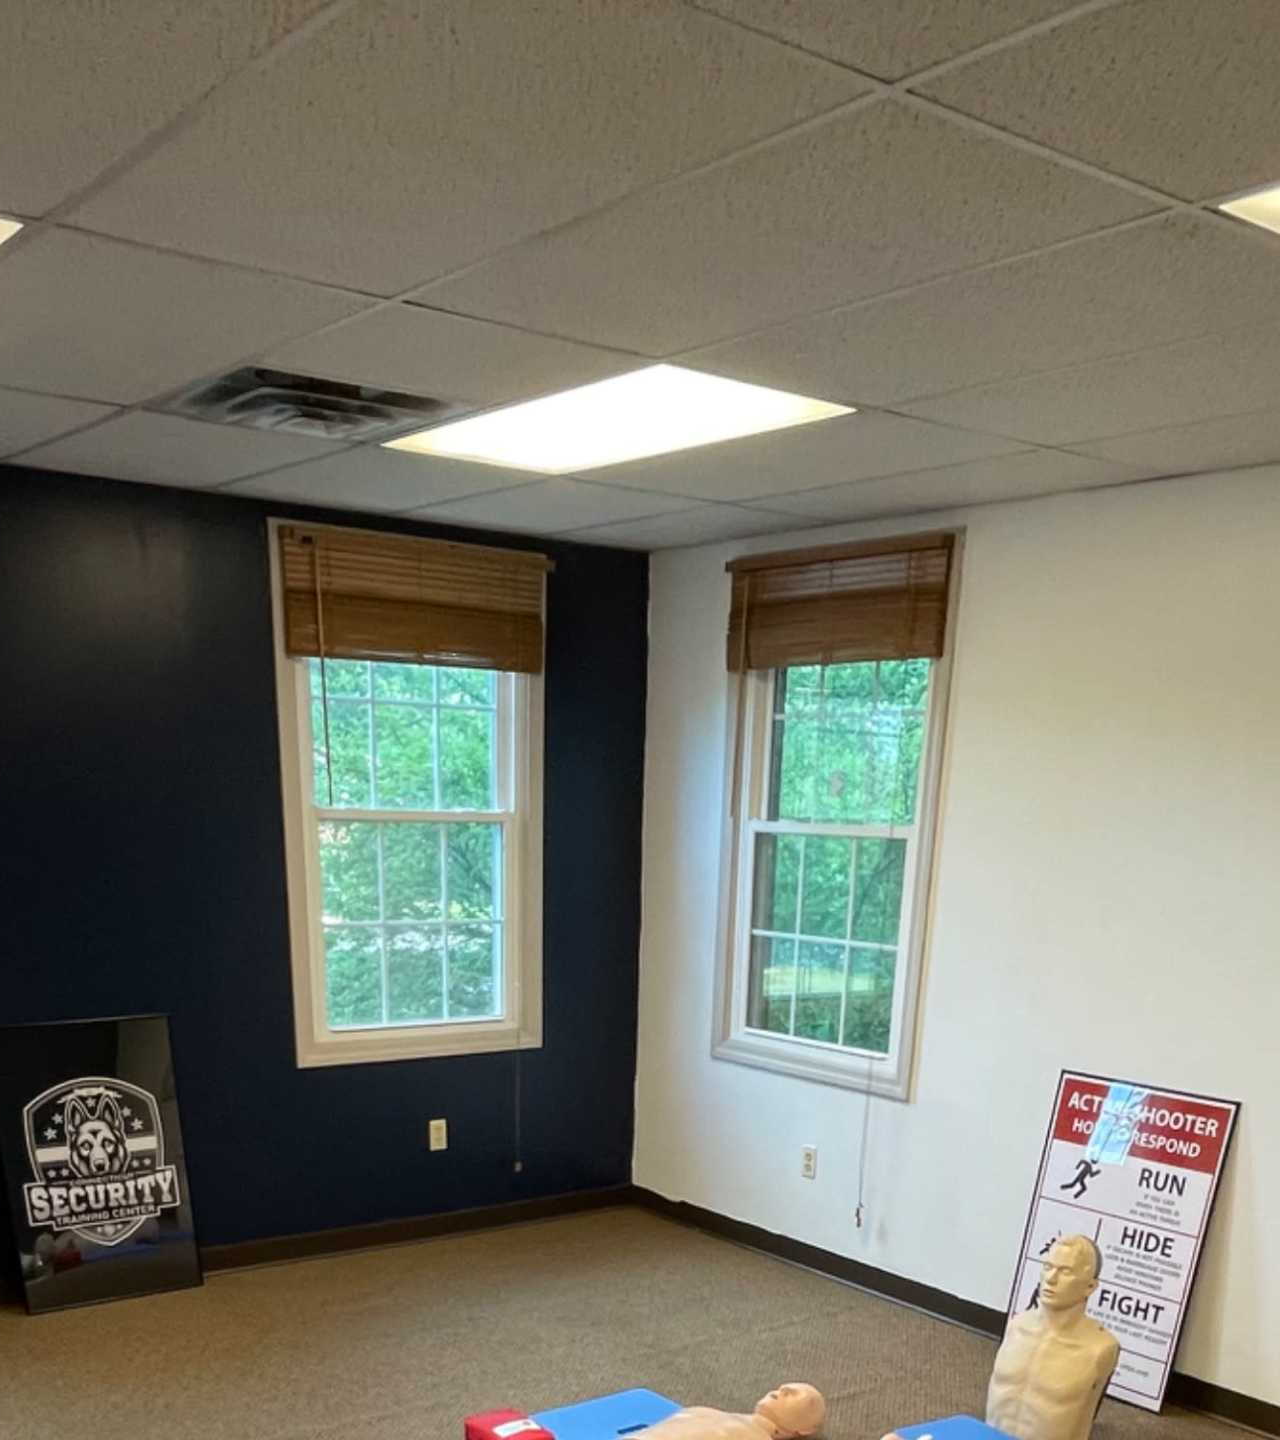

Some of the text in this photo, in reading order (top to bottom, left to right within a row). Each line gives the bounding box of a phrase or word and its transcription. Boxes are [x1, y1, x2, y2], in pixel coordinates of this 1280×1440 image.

[1068, 1091, 1123, 1116] ACT
[1133, 1127, 1201, 1158] RESPOND
[30, 1170, 173, 1220] SECURITY
[1138, 1167, 1187, 1196] RUN
[56, 1205, 155, 1225] TRAINING CENTER
[1120, 1226, 1175, 1258] HIDE
[1098, 1289, 1165, 1324] FIGHT
